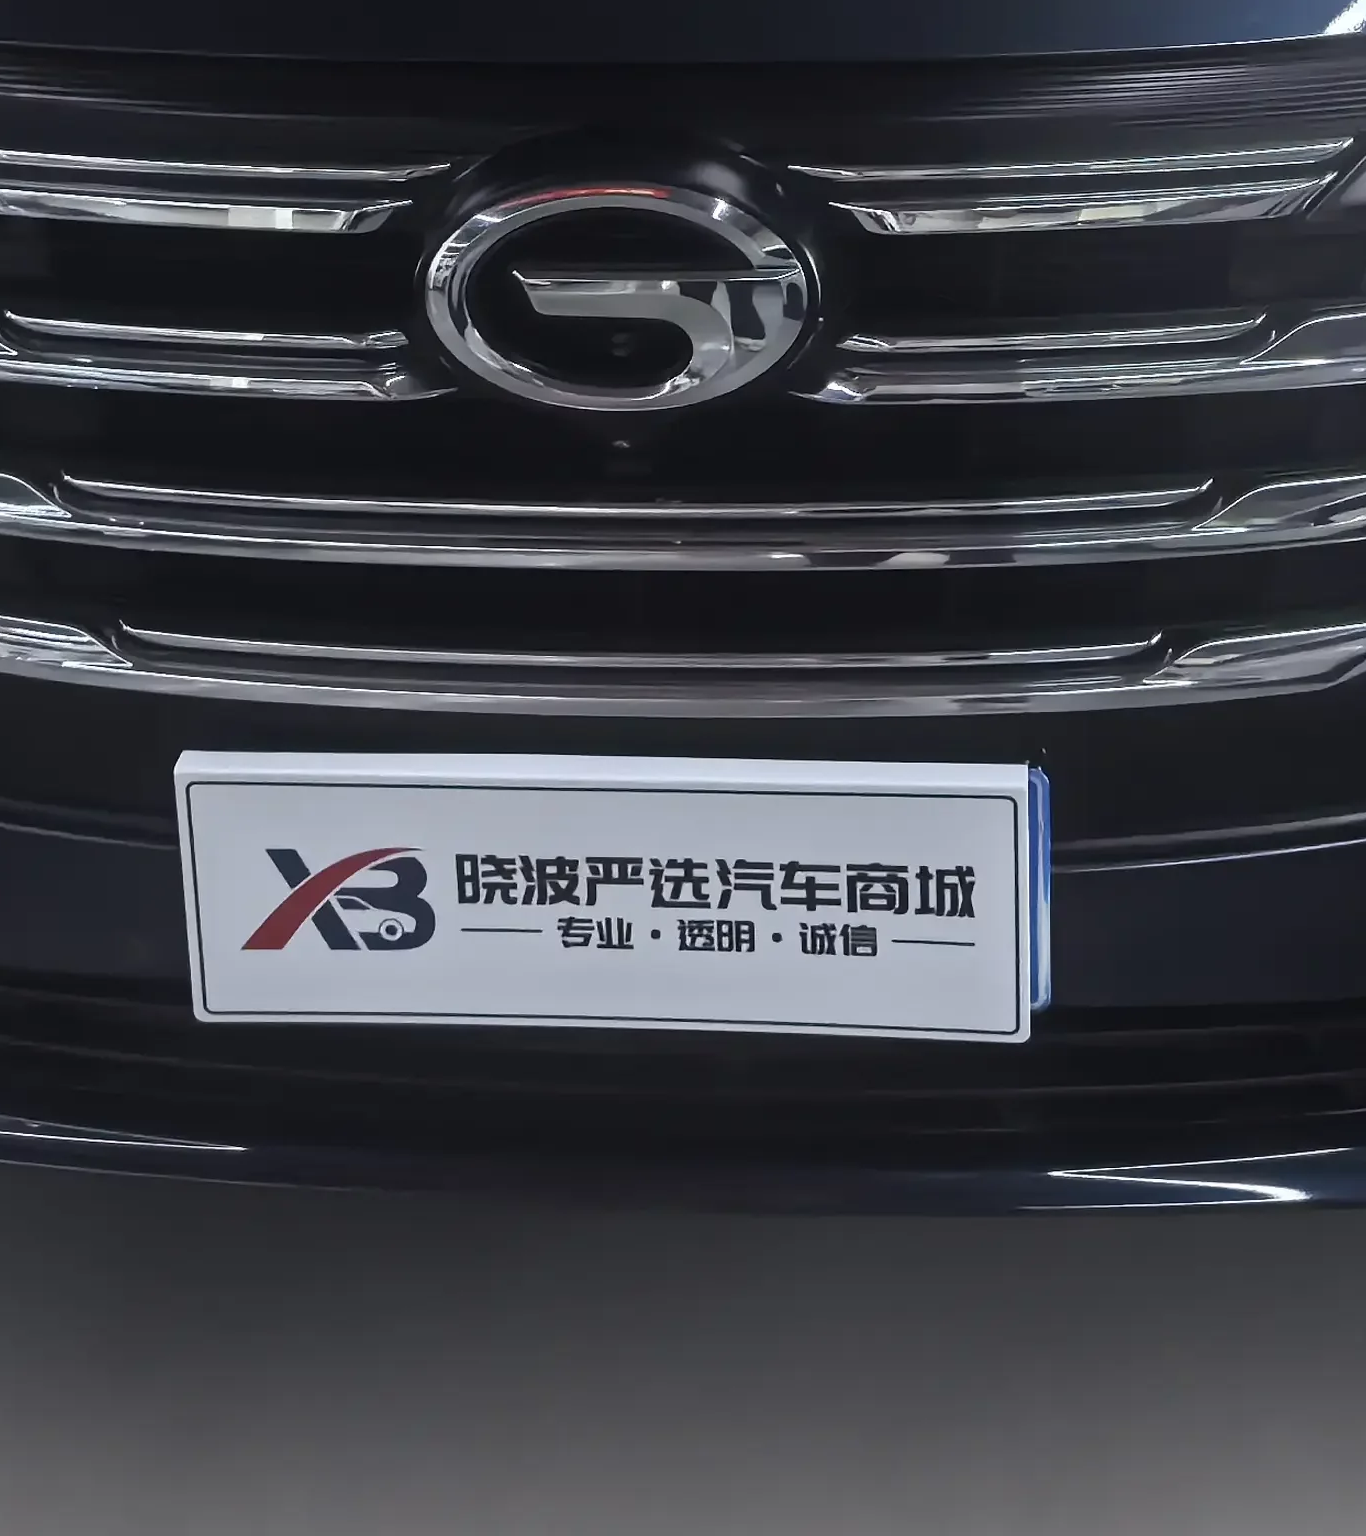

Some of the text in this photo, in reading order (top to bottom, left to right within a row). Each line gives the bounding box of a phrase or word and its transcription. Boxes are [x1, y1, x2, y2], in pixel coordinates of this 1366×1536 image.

[455, 853, 976, 919] 晓波严选汽车商城
